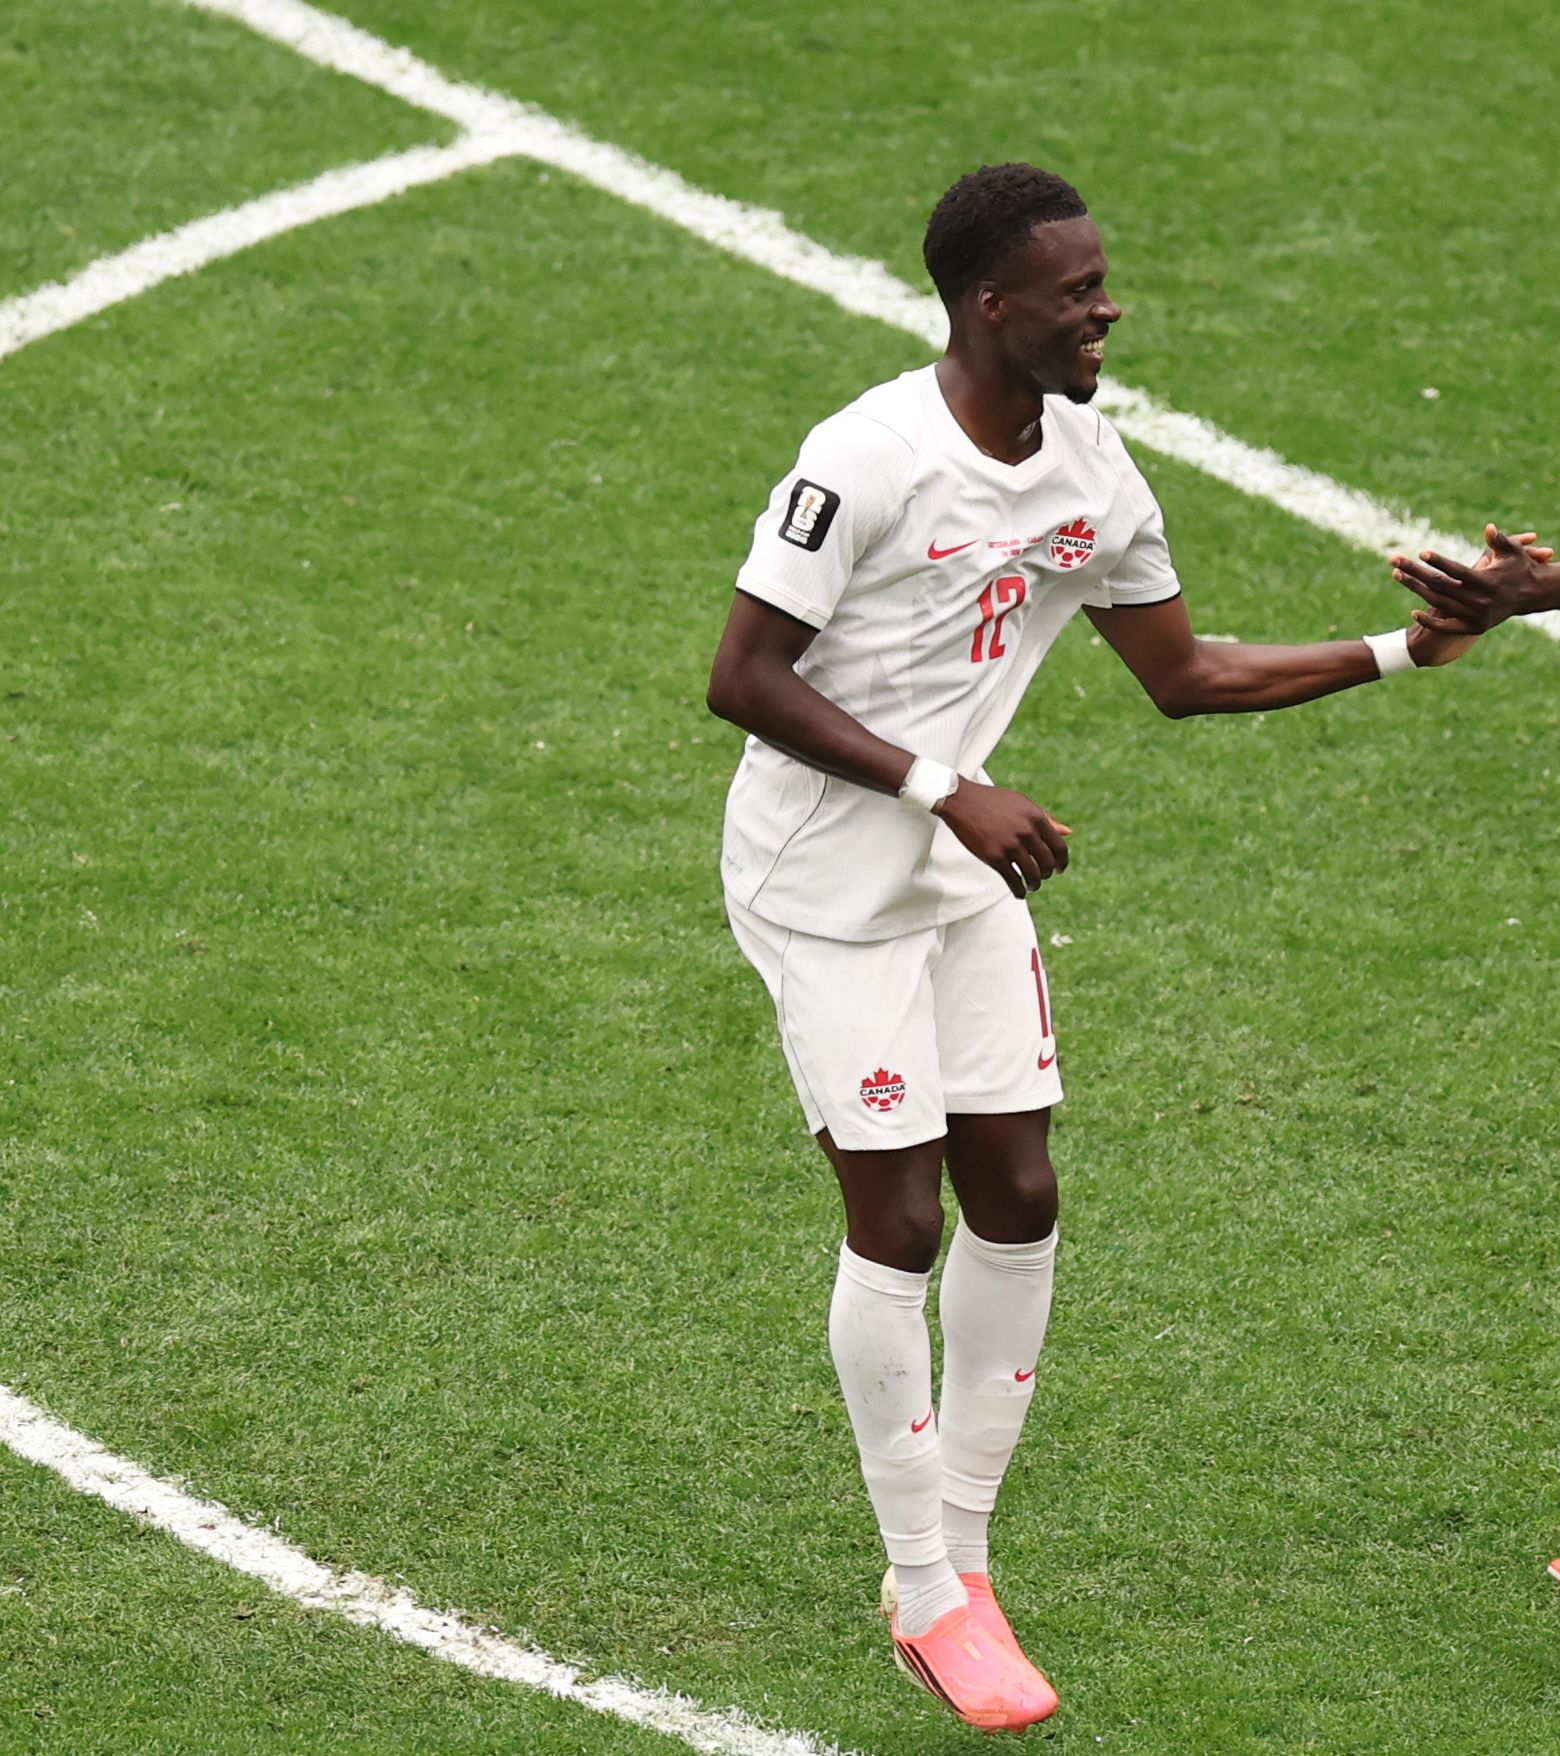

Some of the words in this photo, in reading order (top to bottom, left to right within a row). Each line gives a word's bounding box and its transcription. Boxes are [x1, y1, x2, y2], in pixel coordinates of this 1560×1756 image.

[1051, 536, 1095, 551] CANADA
[971, 577, 1026, 663] 12
[860, 1084, 906, 1097] CANADA
